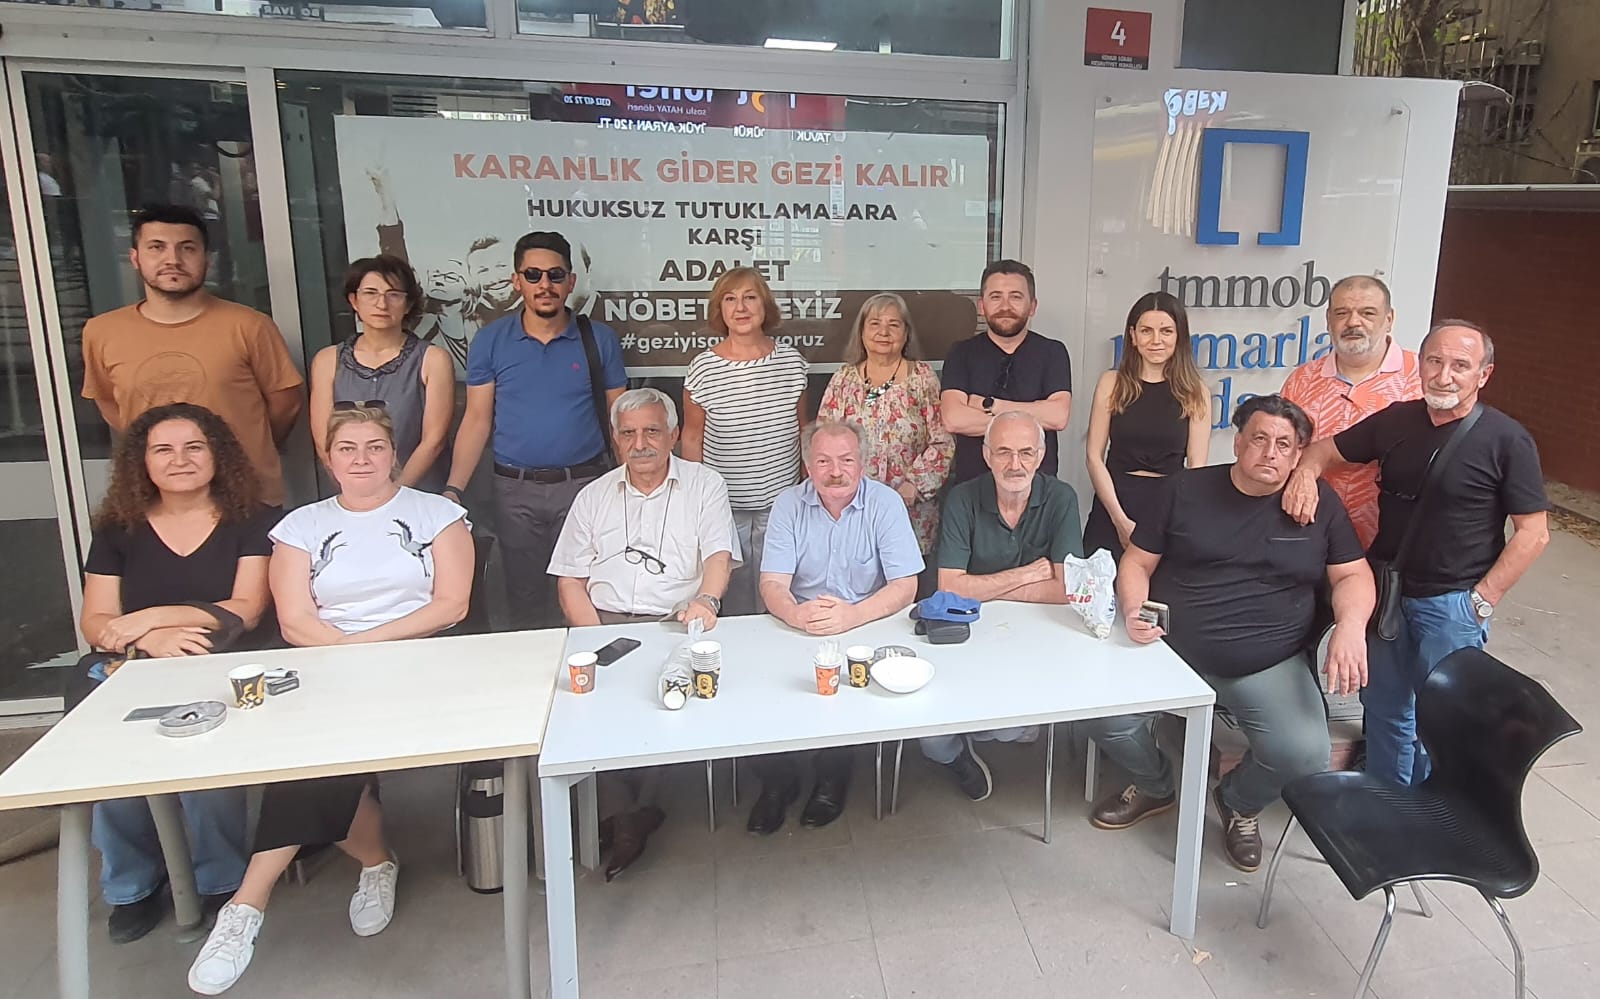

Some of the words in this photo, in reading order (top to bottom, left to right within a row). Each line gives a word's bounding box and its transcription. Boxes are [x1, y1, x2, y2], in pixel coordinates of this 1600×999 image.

[1110, 21, 1126, 46] 4
[454, 153, 643, 182] KARANLIK
[656, 151, 758, 184] GİDER
[771, 155, 842, 185] GEZİ
[856, 163, 949, 188] KALIR
[527, 199, 666, 218] HUKUKSUZ
[675, 201, 897, 220] TUTUKLAMALARA
[1157, 260, 1331, 308] tmmob
[604, 290, 842, 322] NÖBETEYİZ
